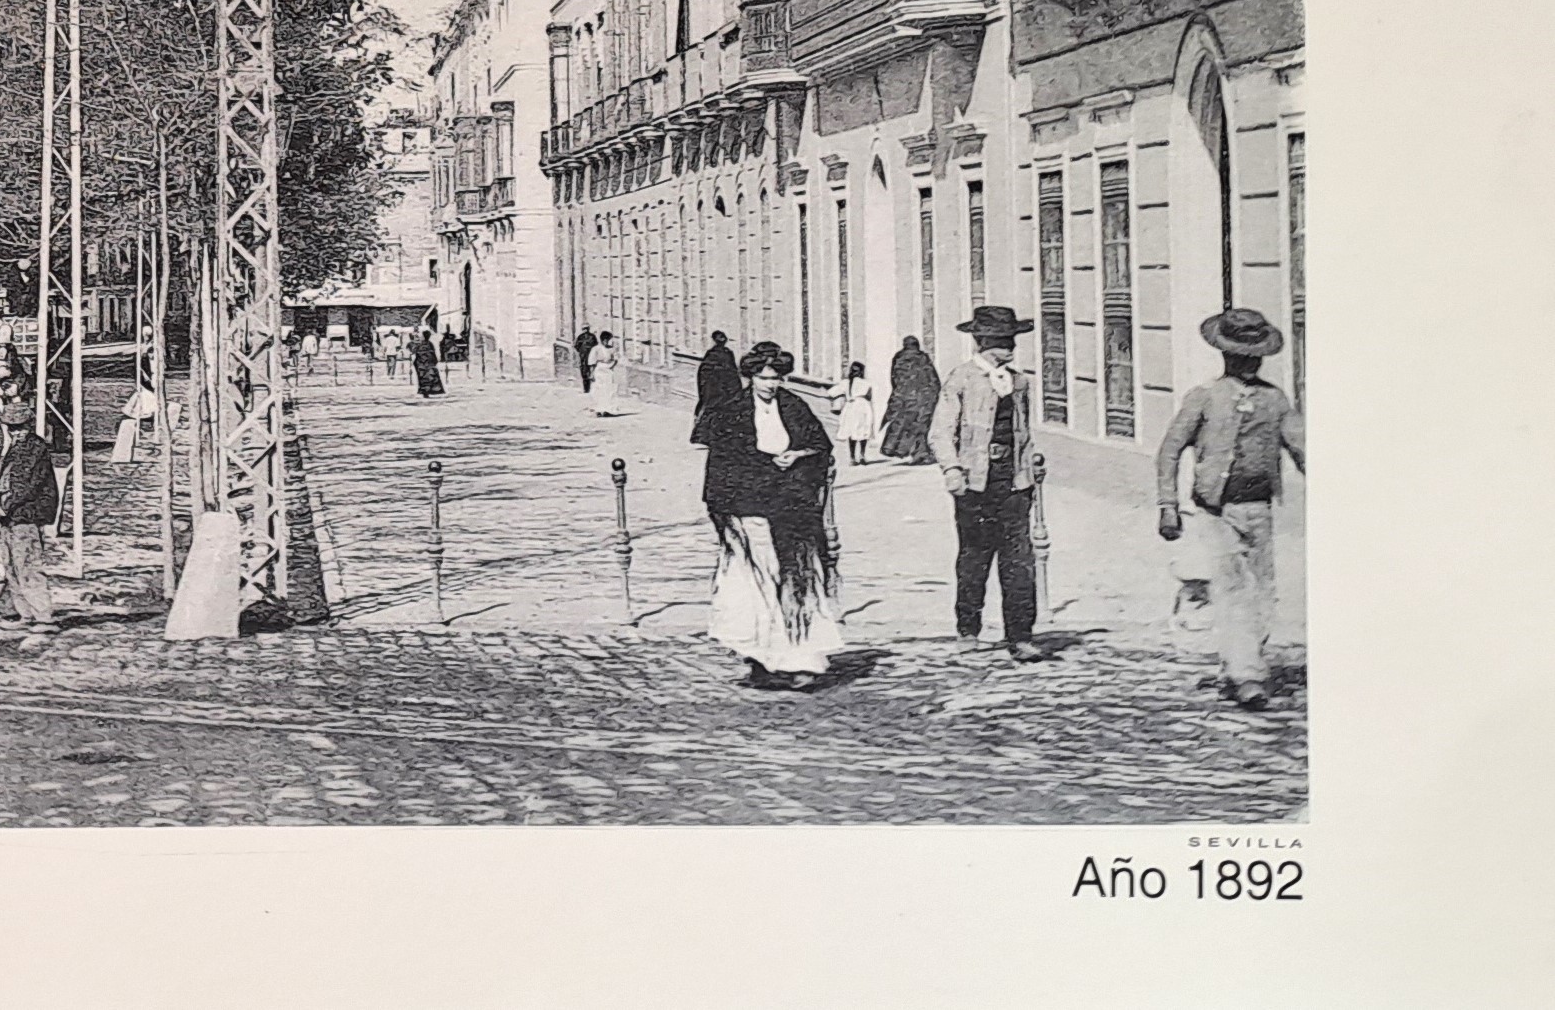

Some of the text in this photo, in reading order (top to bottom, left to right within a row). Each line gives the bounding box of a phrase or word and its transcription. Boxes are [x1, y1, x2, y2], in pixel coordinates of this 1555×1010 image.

[1187, 836, 1305, 850] SEVILLA
[1071, 855, 1305, 902] Año 1892
